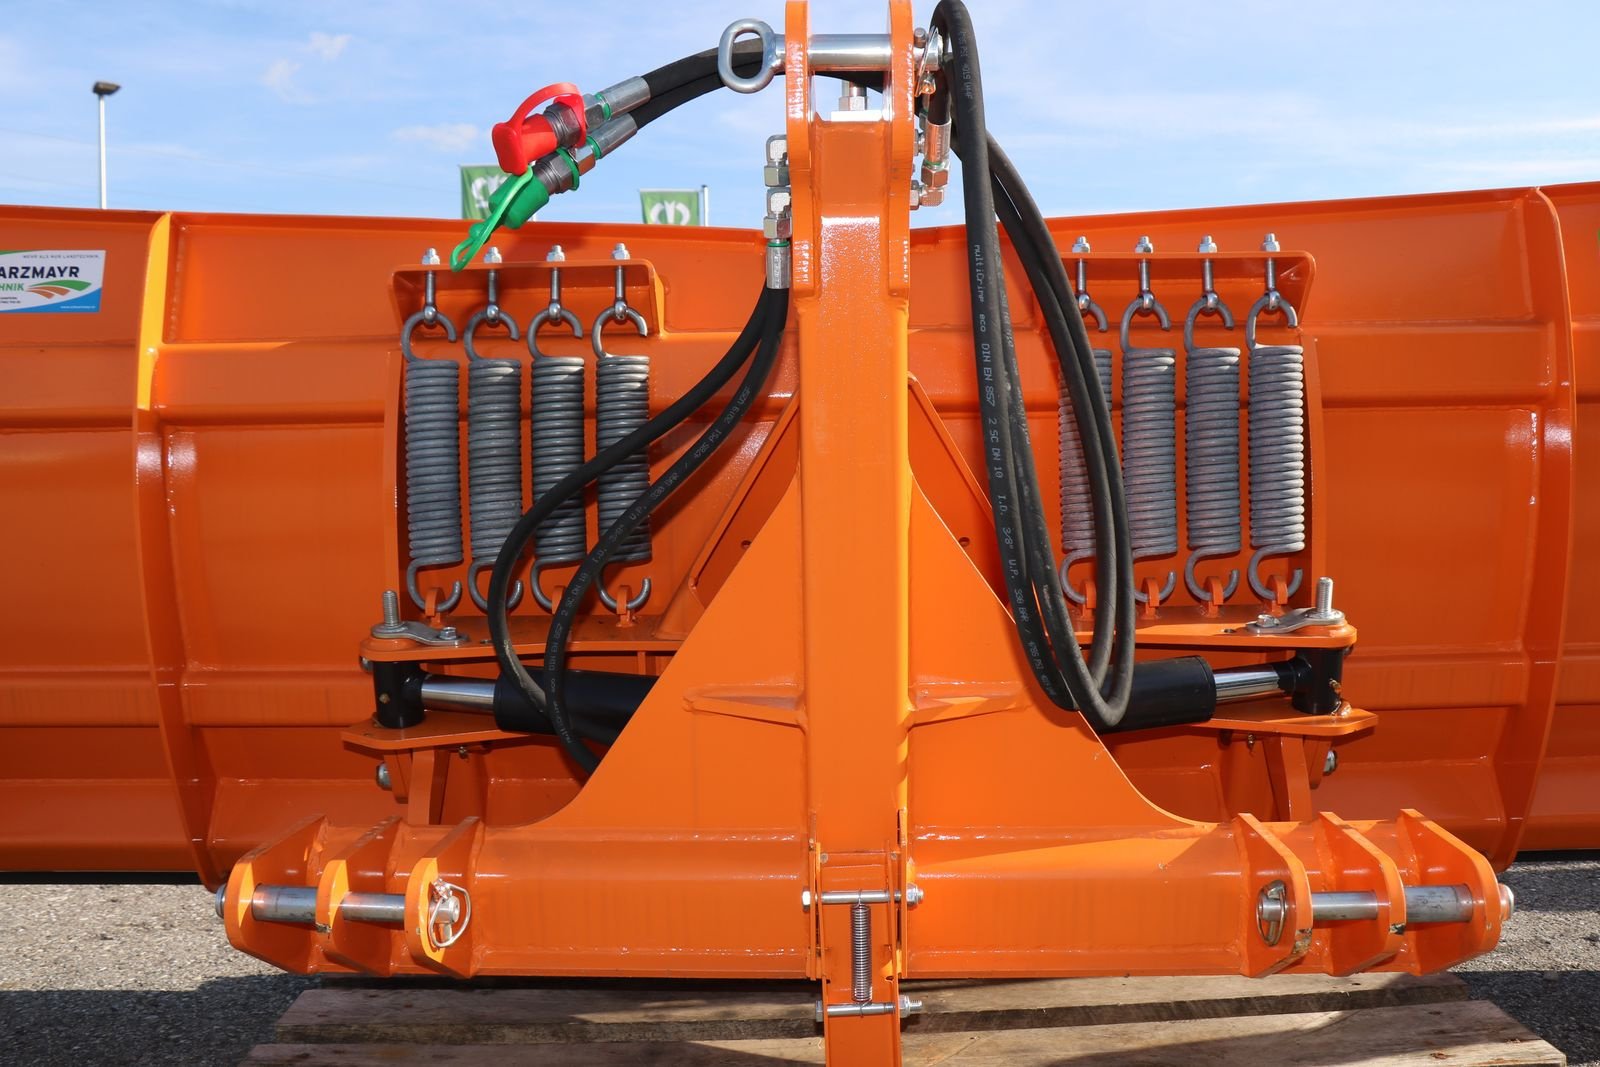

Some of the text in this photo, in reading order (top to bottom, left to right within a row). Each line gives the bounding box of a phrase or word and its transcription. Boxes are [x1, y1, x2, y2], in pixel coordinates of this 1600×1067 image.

[0, 266, 80, 279] ARZMAYR
[0, 283, 24, 291] HNIK
[979, 313, 987, 333] eco
[981, 343, 991, 363] DIN
[983, 367, 993, 382] EN
[985, 385, 996, 408] 857
[988, 417, 998, 425] 2
[989, 429, 999, 443] SC
[991, 447, 1001, 461] DN
[994, 466, 1004, 479] 10
[997, 495, 1008, 516] I.D.
[560, 609, 569, 617] 2
[1019, 606, 1030, 622] BAR
